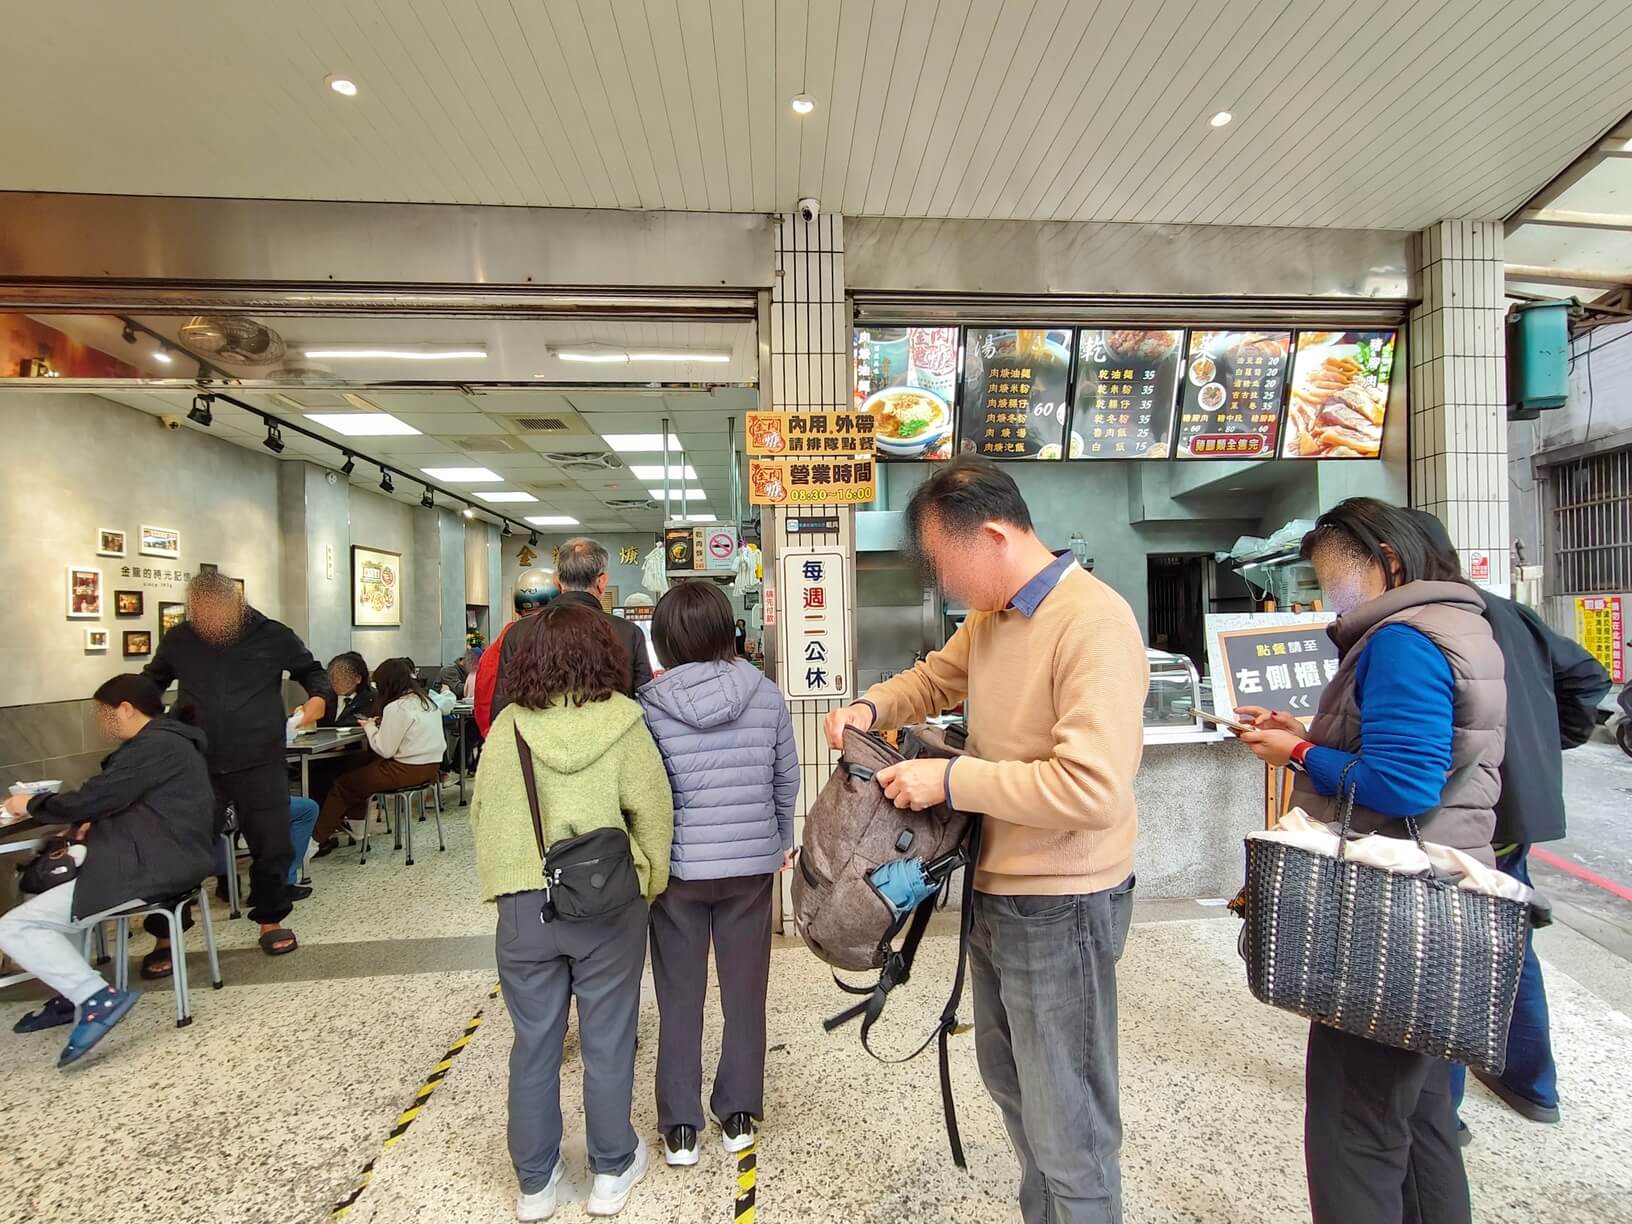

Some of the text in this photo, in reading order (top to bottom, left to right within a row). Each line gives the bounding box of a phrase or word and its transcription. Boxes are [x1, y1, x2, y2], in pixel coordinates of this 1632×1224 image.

[1268, 357, 1280, 366] 20
[1143, 370, 1156, 380] 35
[1266, 368, 1279, 377] 20
[1264, 380, 1277, 388] 20
[1141, 385, 1154, 395] 35
[1263, 391, 1275, 400] 25
[1034, 402, 1054, 416] 60
[1140, 400, 1153, 410] 35
[1261, 402, 1273, 410] 35
[1138, 414, 1151, 424] 35
[1137, 428, 1150, 438] 25
[789, 437, 874, 451] 請排隊點餐
[1135, 442, 1147, 451] 15
[790, 462, 872, 485] 營業時間
[802, 560, 827, 689] 每週二公休
[1256, 640, 1319, 656] 點餐請至
